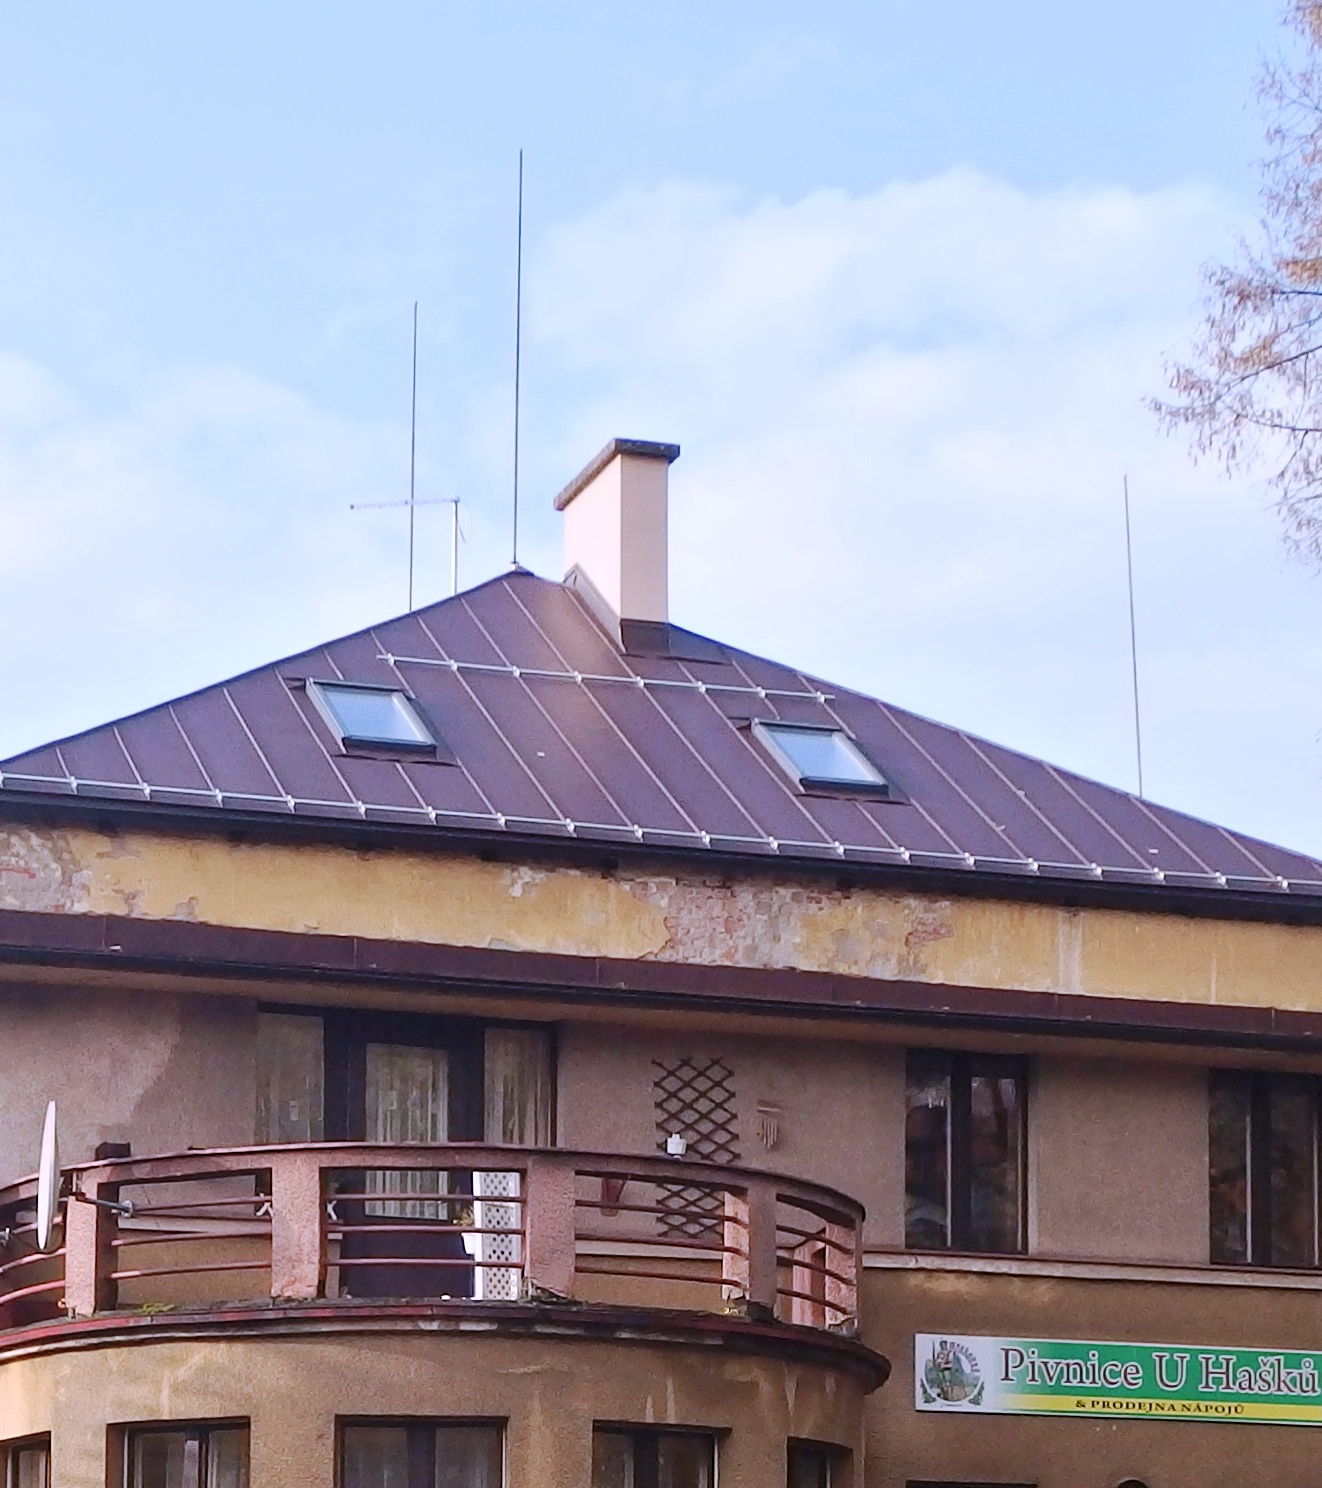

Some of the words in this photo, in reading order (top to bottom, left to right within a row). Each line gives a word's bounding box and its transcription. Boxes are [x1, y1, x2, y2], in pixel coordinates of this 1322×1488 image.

[1000, 1346, 1143, 1388] Pivnice
[1152, 1352, 1188, 1391] U
[1198, 1355, 1320, 1395] Hašků
[1075, 1399, 1086, 1409] &
[1091, 1400, 1177, 1413] PRODEJNA
[1180, 1402, 1245, 1416] NÁPOJŮ
